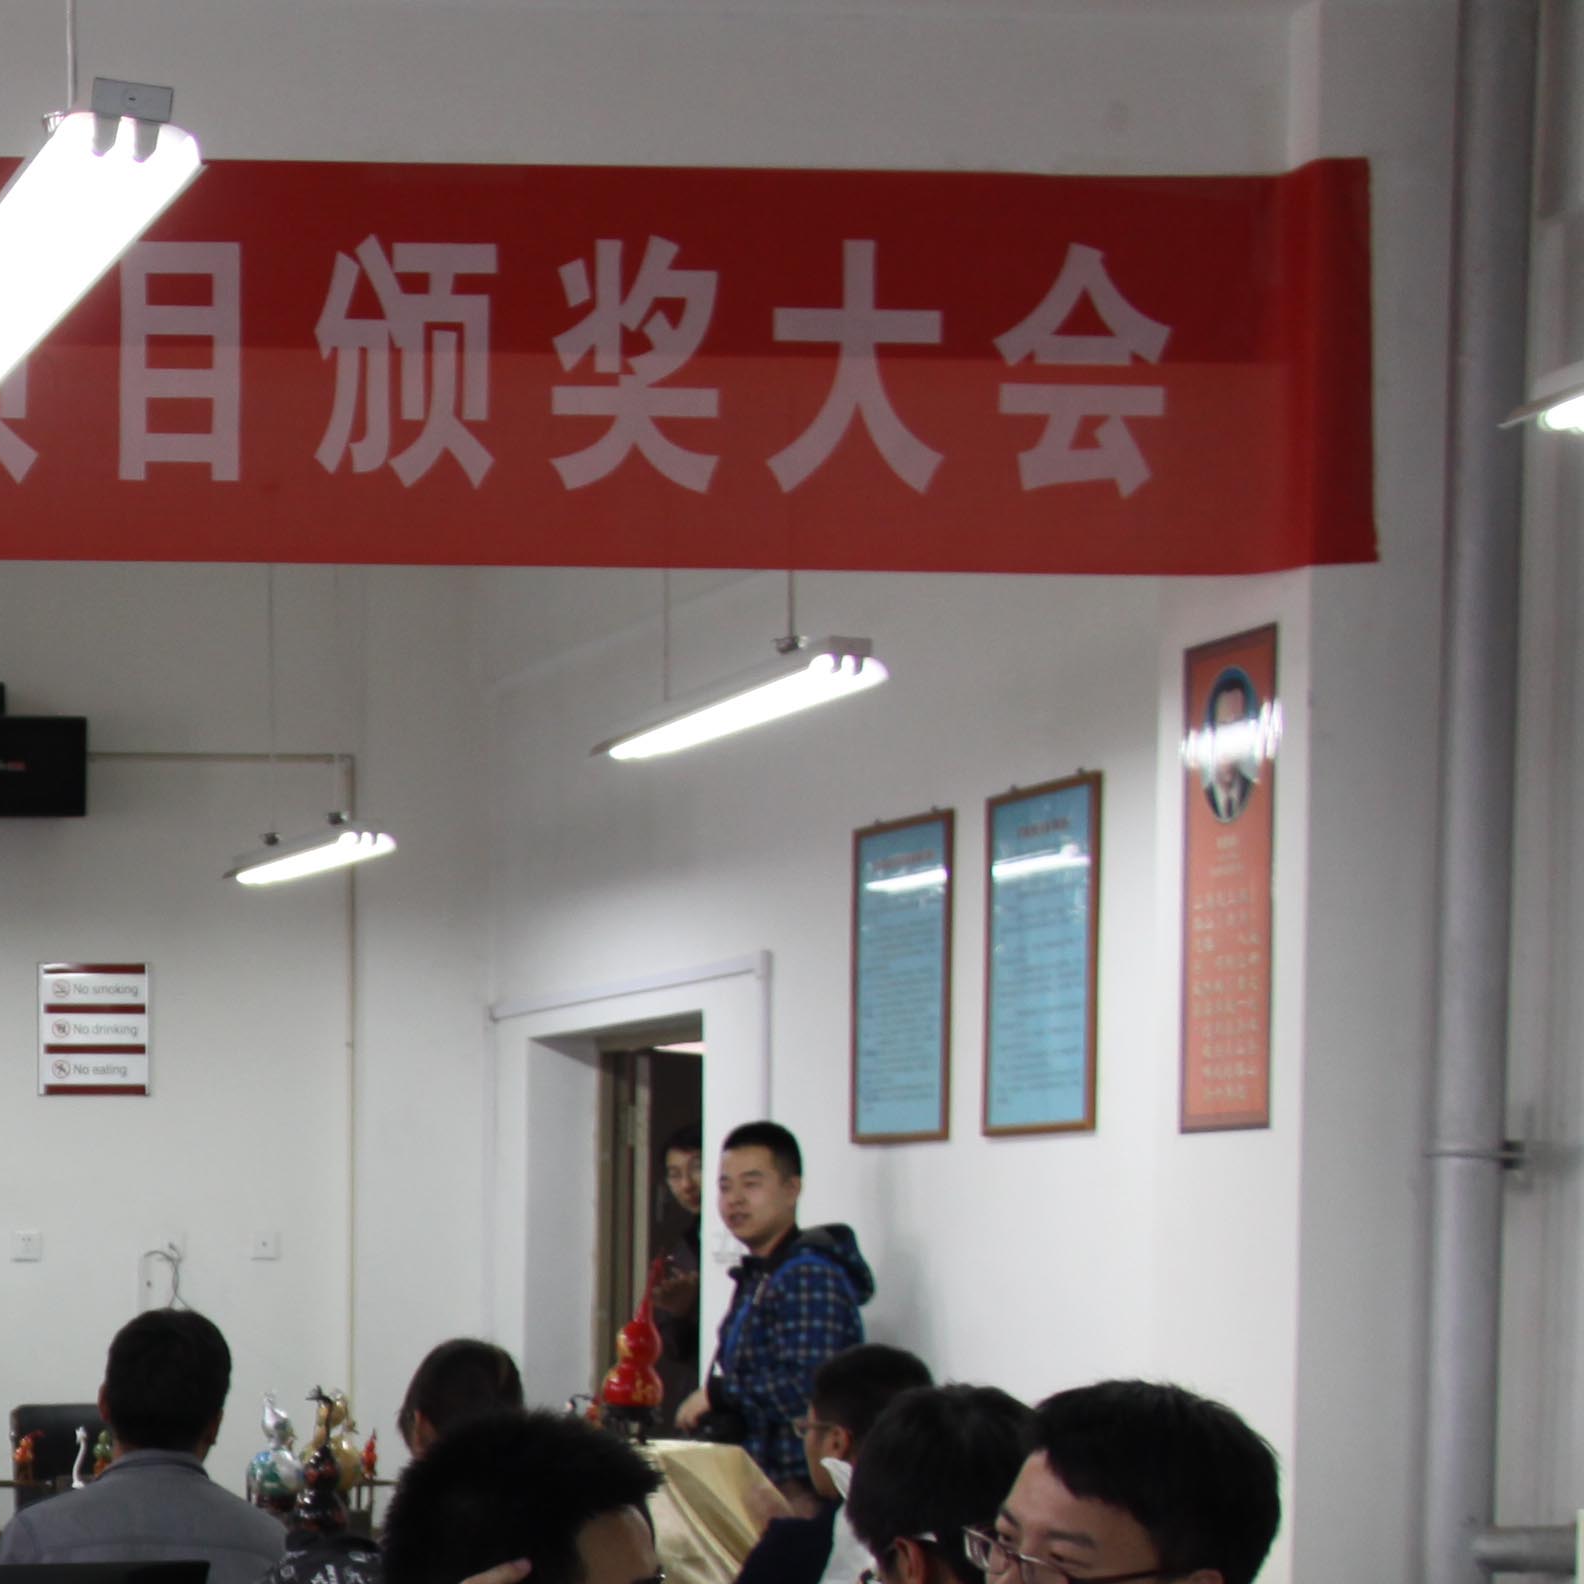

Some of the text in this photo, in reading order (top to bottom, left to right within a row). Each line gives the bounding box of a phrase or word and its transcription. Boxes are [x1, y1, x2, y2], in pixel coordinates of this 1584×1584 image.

[73, 984, 138, 997] No smoking
[73, 1024, 138, 1037] No drinking
[73, 1064, 128, 1077] No eating
